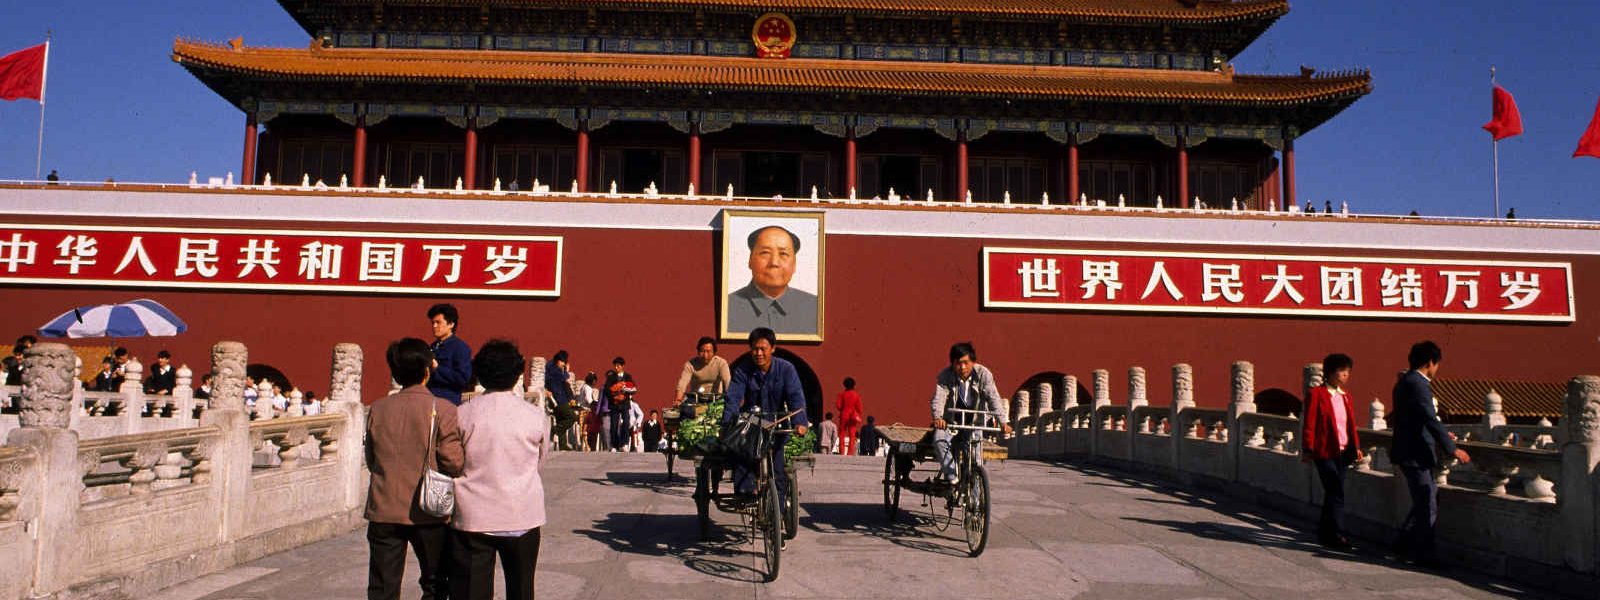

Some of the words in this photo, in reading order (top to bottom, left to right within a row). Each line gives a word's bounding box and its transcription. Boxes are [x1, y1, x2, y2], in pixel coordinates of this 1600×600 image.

[0, 233, 528, 284] 中华人民共和国万岁
[1018, 259, 1542, 310] 世界人民大团结万岁
